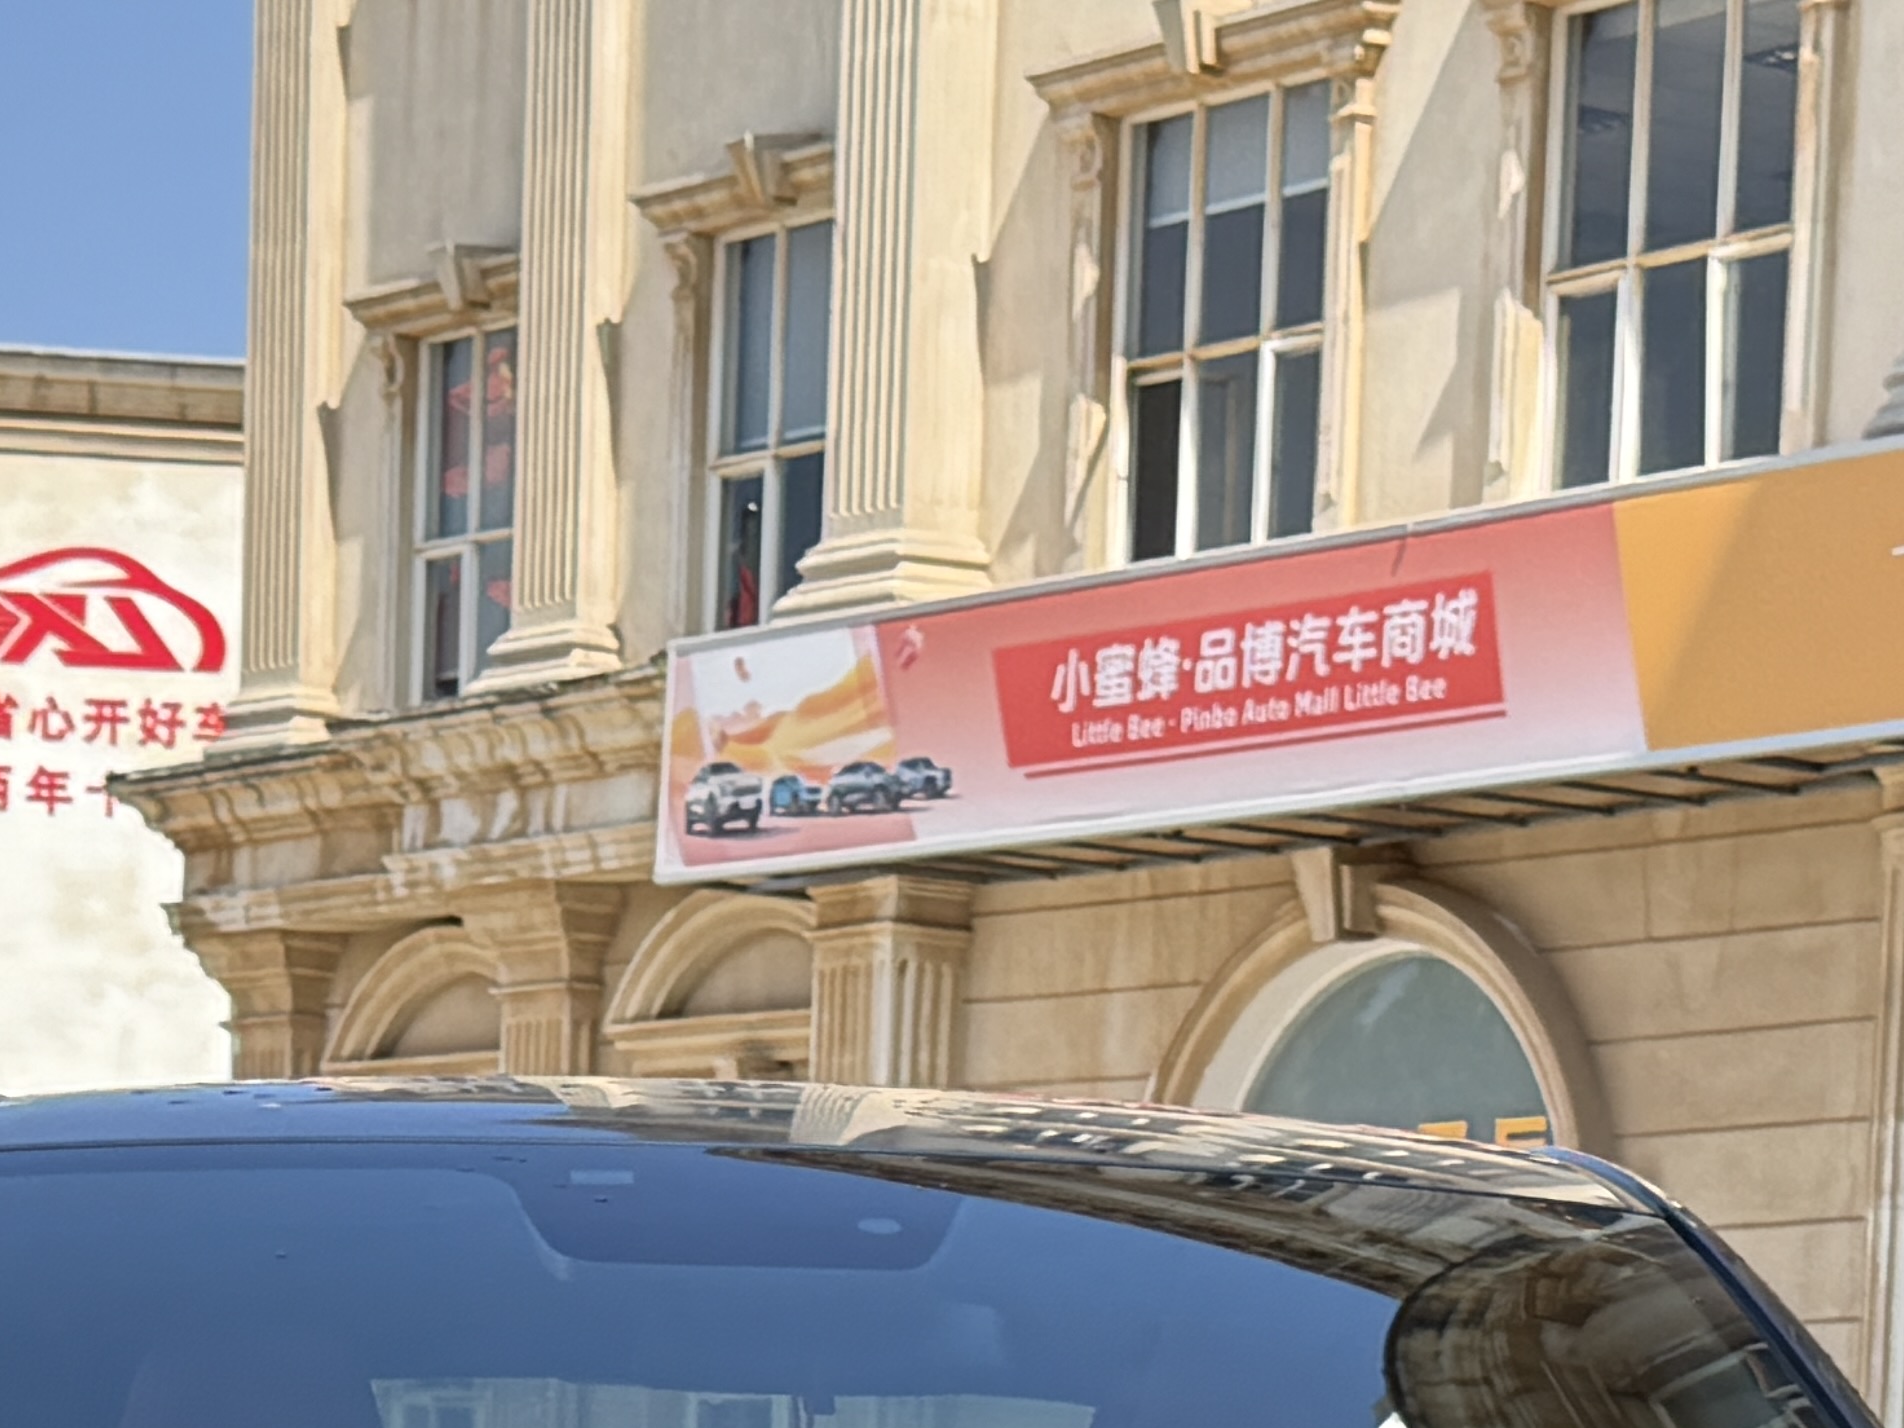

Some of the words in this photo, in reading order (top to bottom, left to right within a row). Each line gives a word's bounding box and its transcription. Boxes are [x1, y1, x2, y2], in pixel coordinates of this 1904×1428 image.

[1071, 717, 1124, 748] Little
[1127, 713, 1166, 741] Bee
[1242, 697, 1290, 725] Auto
[1294, 688, 1340, 718] Mall
[1344, 679, 1401, 712] Little
[1405, 674, 1447, 703] Bee
